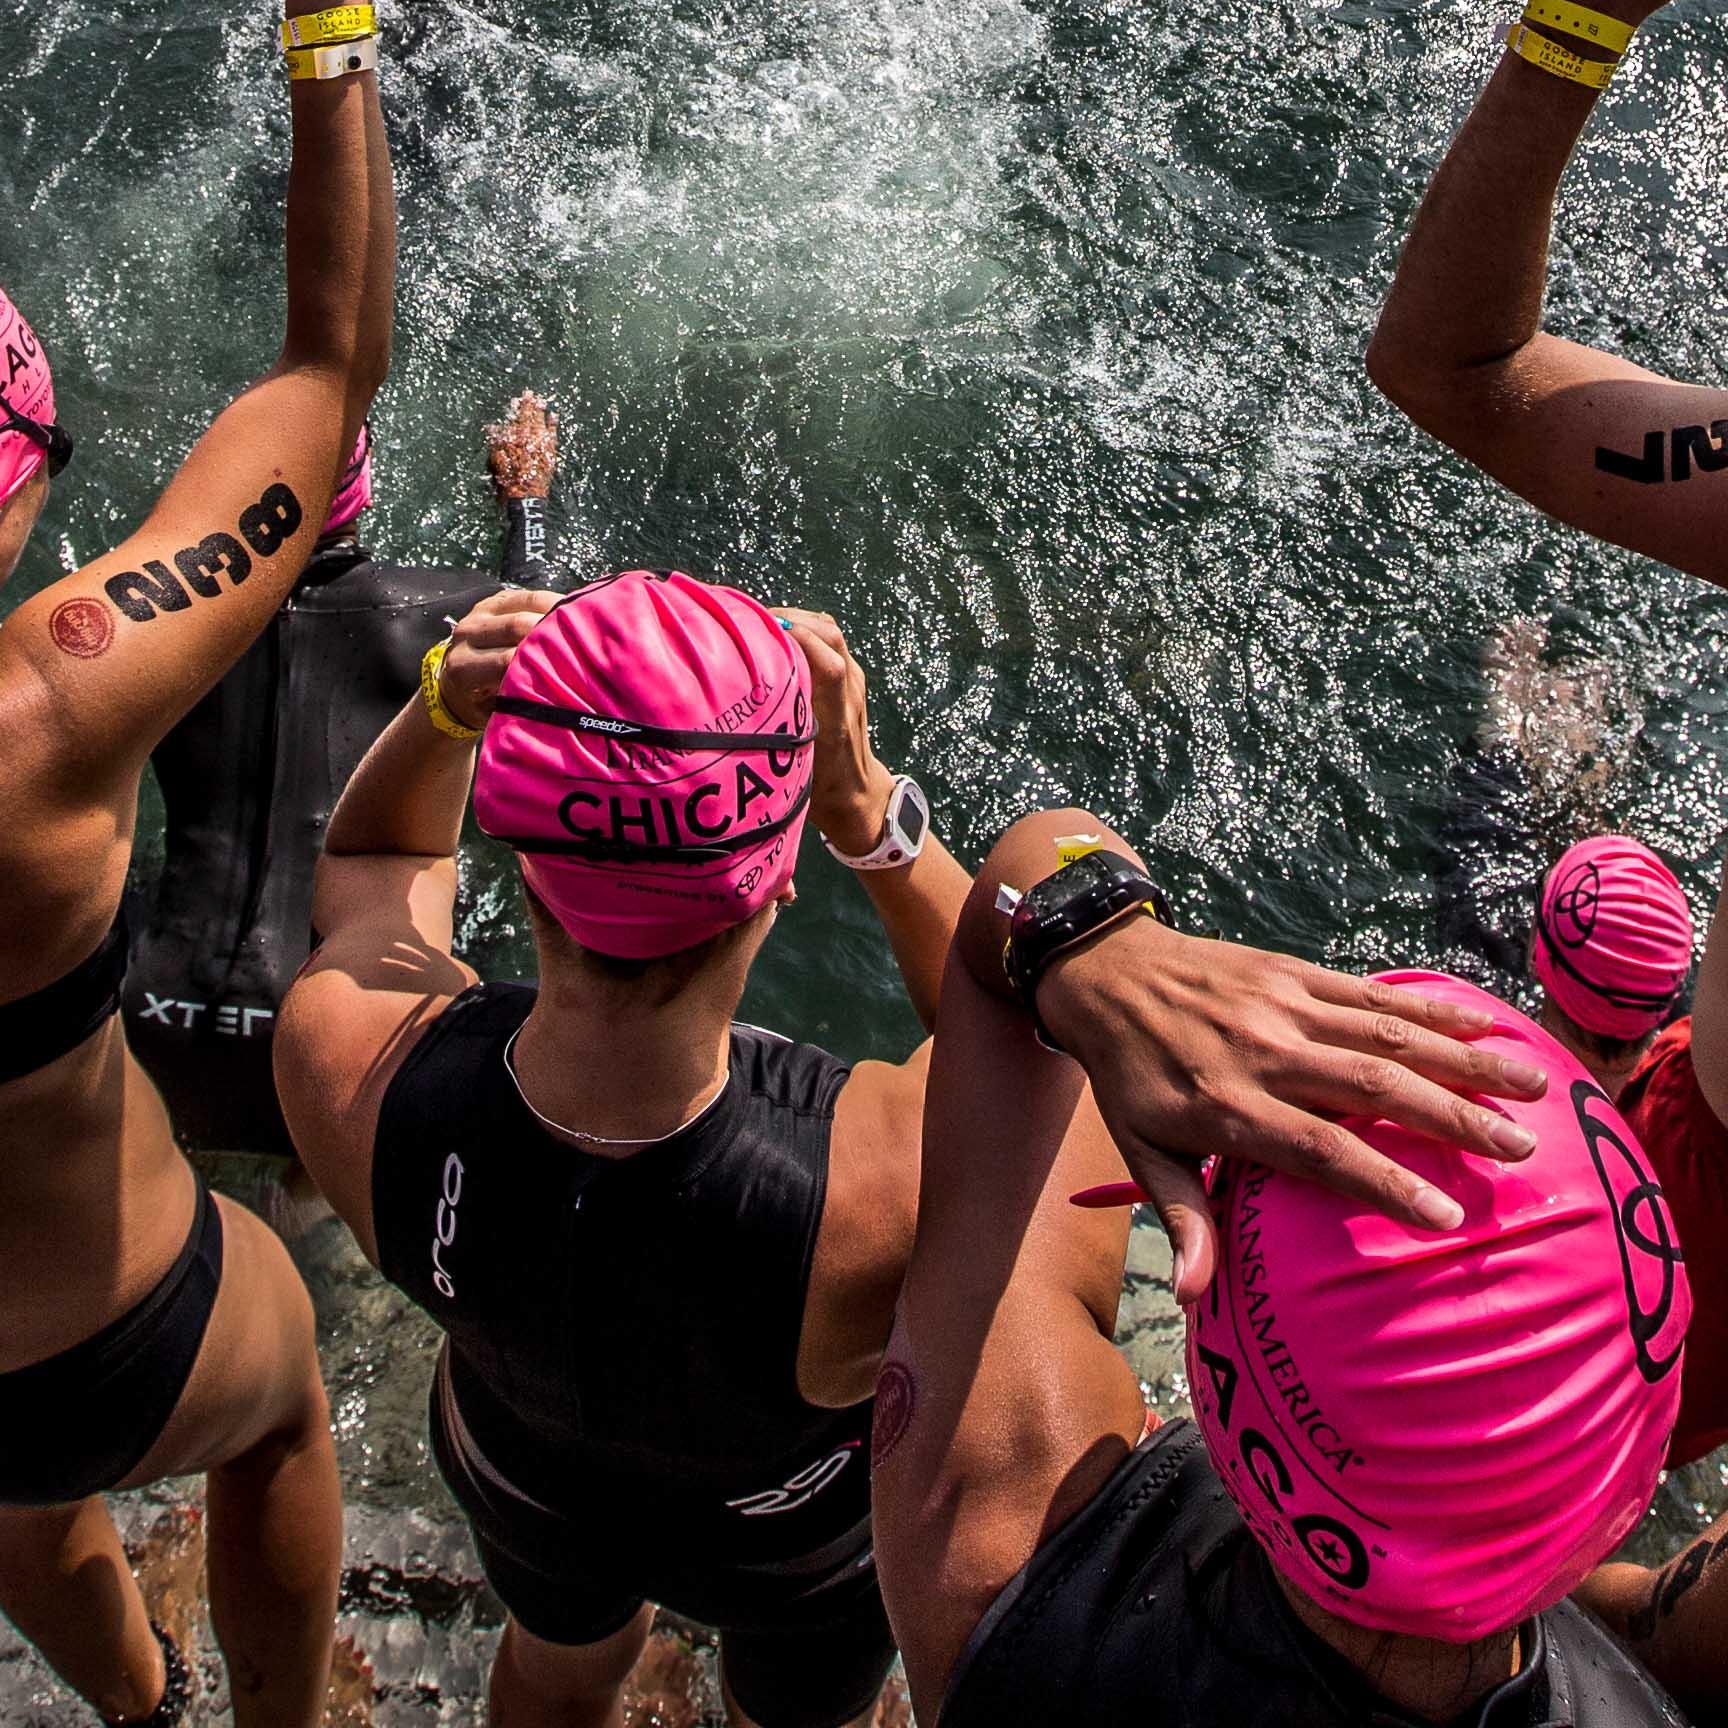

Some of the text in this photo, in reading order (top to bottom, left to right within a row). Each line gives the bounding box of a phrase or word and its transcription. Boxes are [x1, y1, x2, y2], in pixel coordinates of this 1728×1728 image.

[316, 7, 361, 21] GOOSE
[318, 18, 362, 31] ISLAND
[1538, 51, 1582, 74] ISLAND
[1543, 41, 1585, 66] GOOSE
[104, 481, 304, 623] 238
[579, 715, 624, 735] speedo
[432, 1152, 465, 1298] orca
